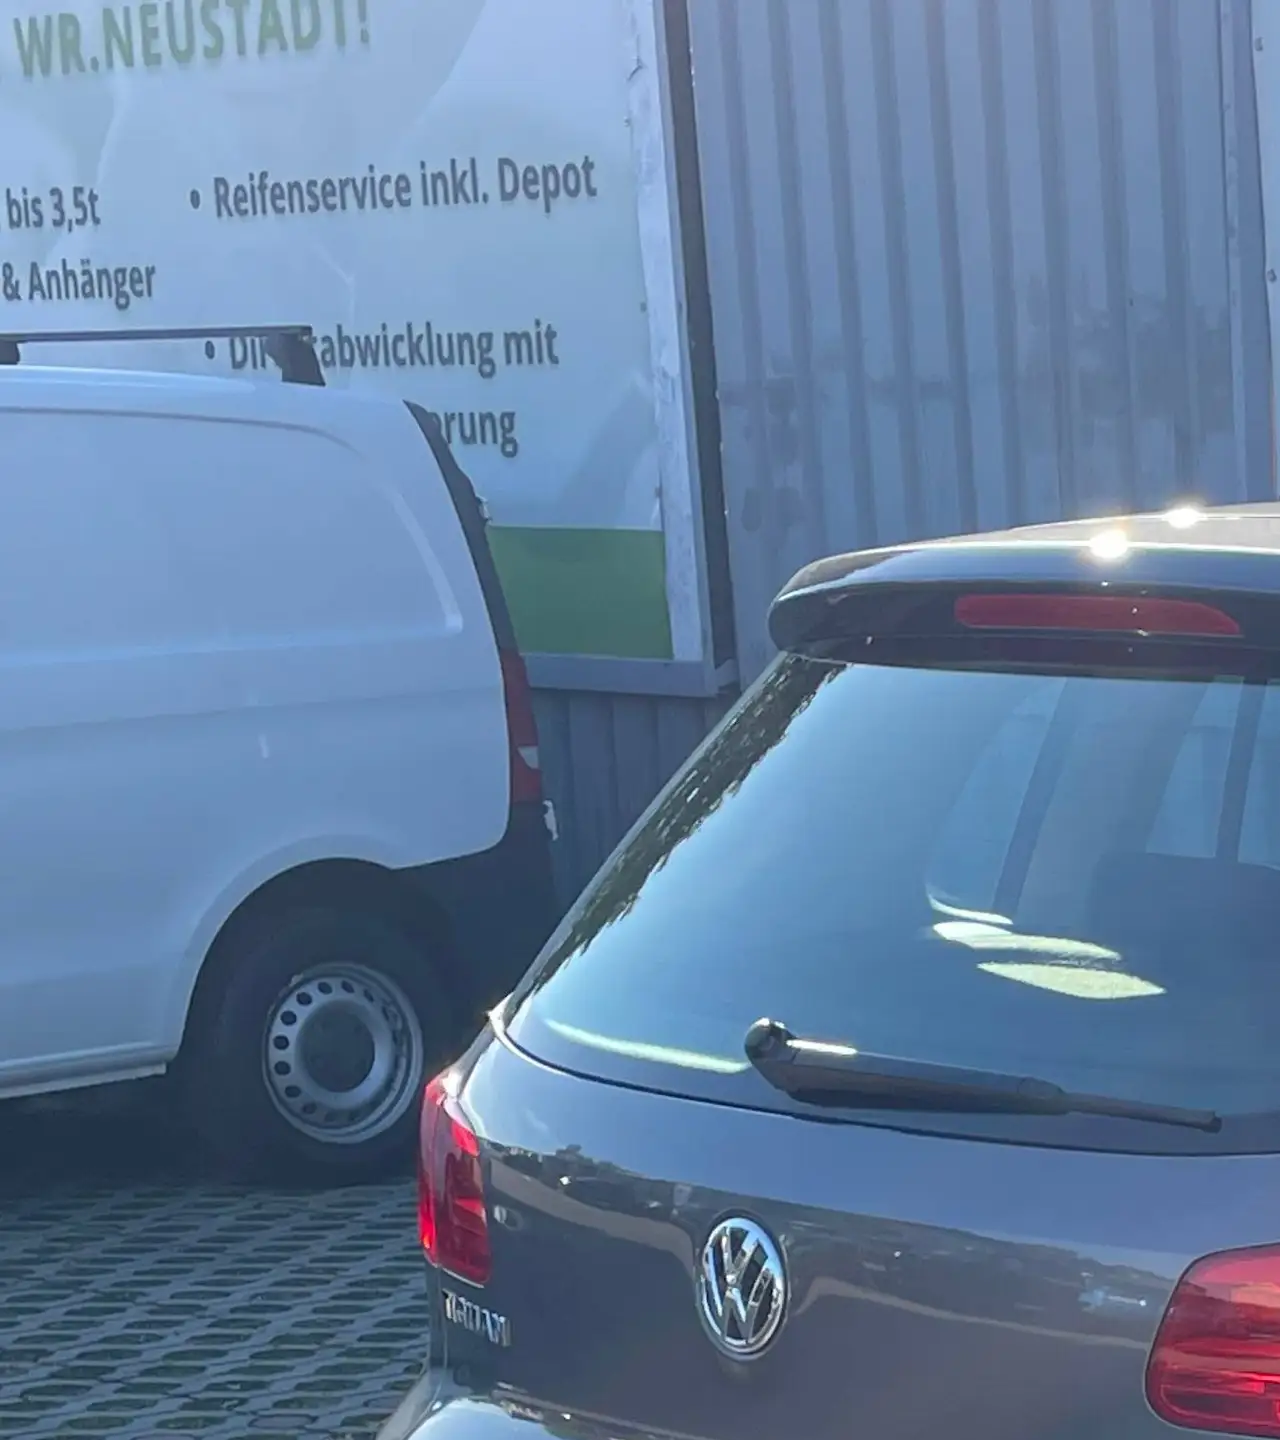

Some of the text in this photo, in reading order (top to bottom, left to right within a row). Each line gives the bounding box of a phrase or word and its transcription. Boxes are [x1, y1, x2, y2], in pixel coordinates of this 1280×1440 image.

[6, 185, 101, 233] bis 3,5t
[212, 154, 598, 219] Reifenservice inkl. Depot
[28, 258, 156, 311] Anhänger
[503, 318, 559, 366] mit
